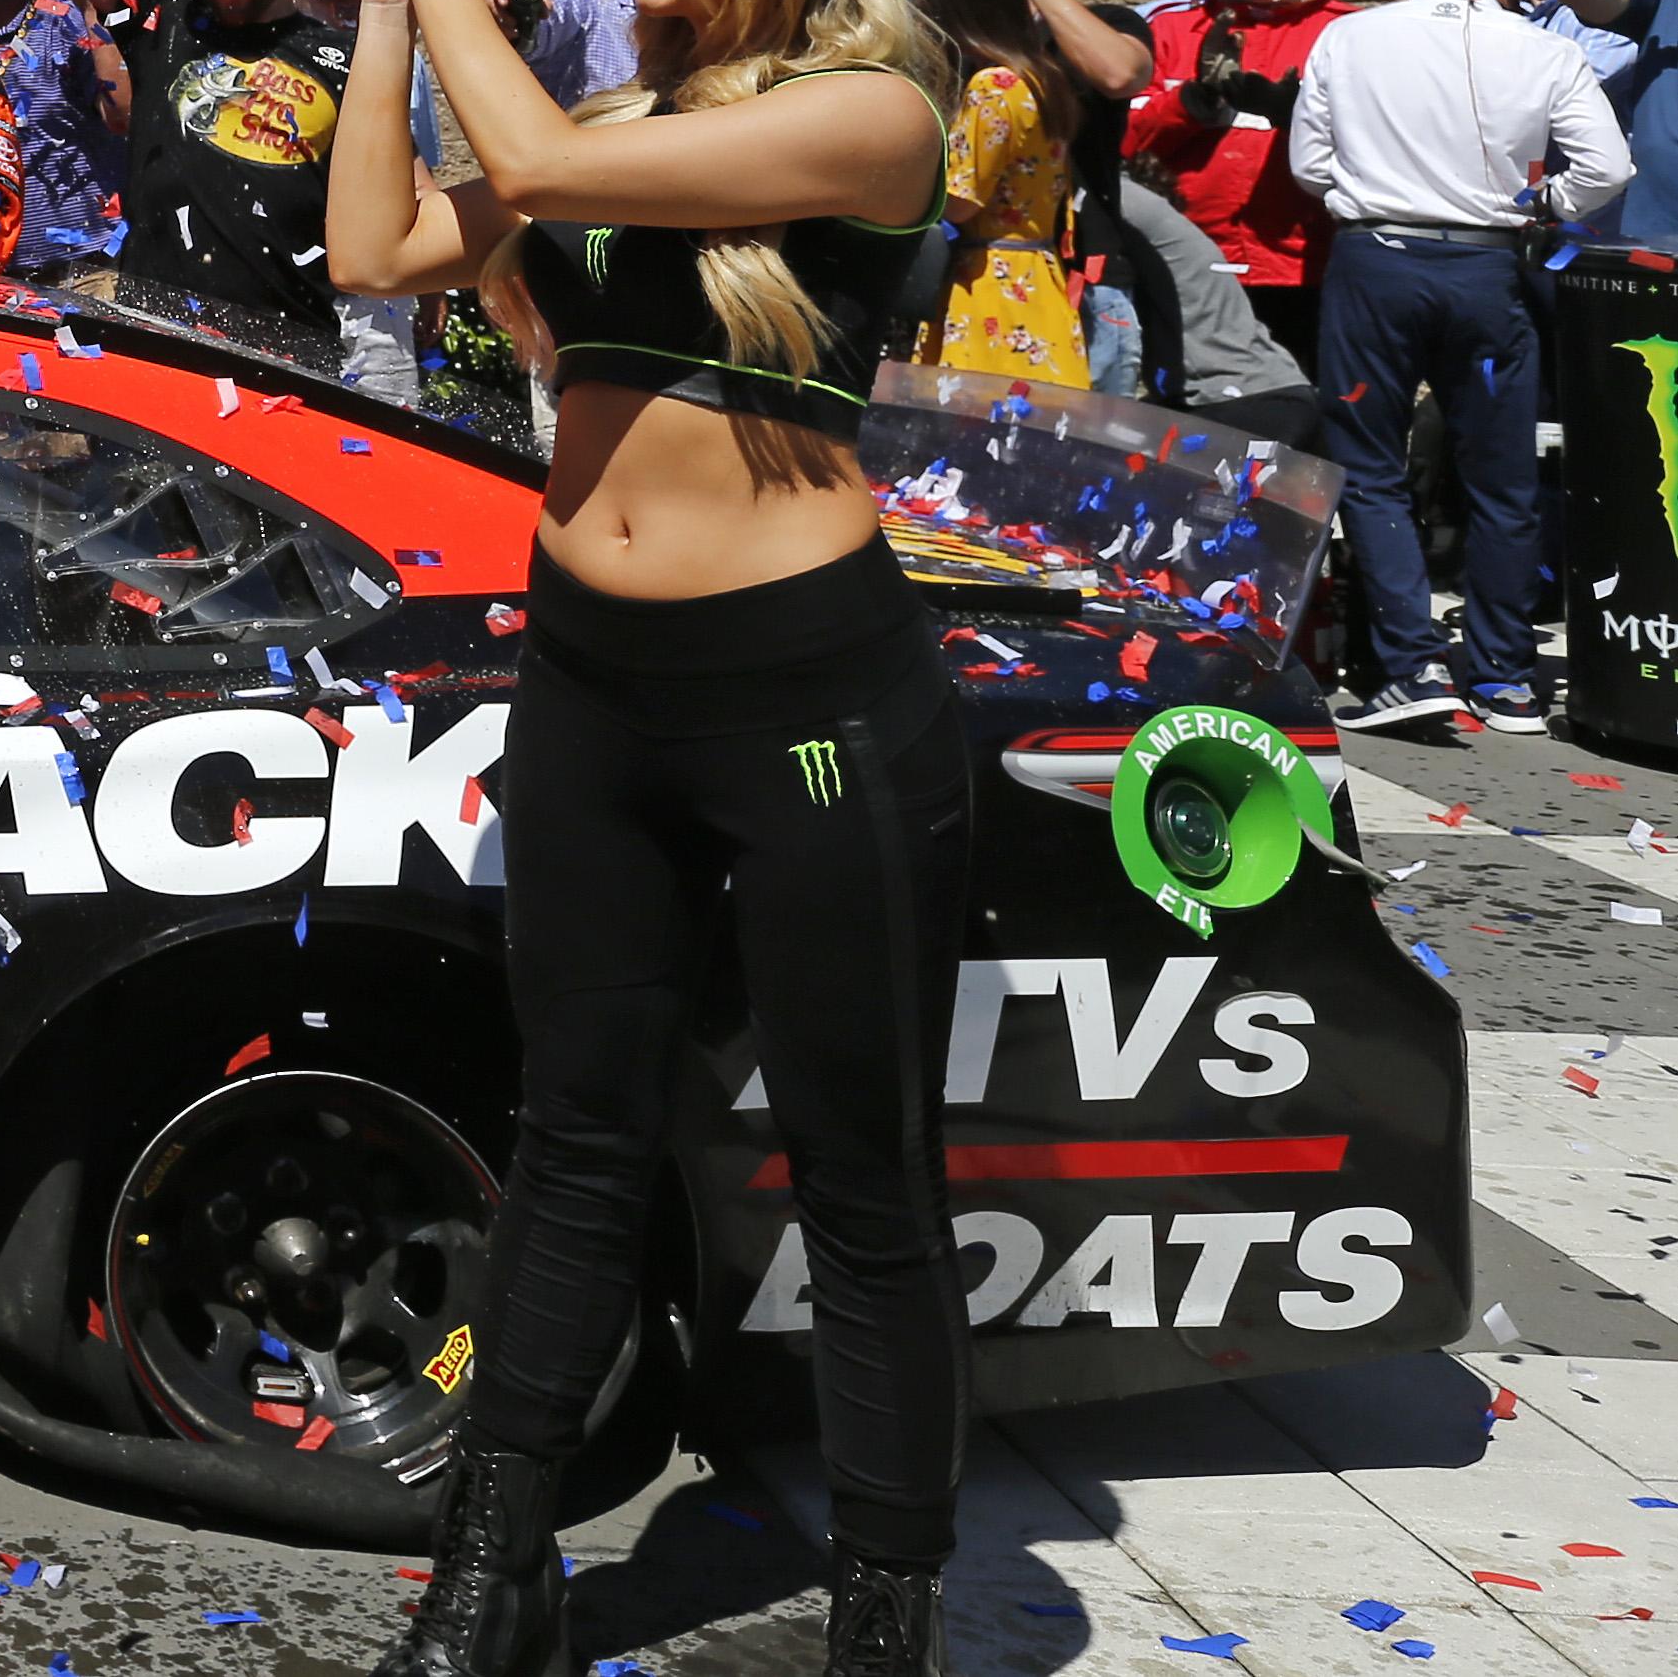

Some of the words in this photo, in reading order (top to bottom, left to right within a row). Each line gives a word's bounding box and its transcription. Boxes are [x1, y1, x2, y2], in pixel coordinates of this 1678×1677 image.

[246, 90, 296, 121] Pro
[248, 62, 316, 105] Bass
[1134, 711, 1299, 778] AMERICAN
[436, 1333, 468, 1382] AERO
